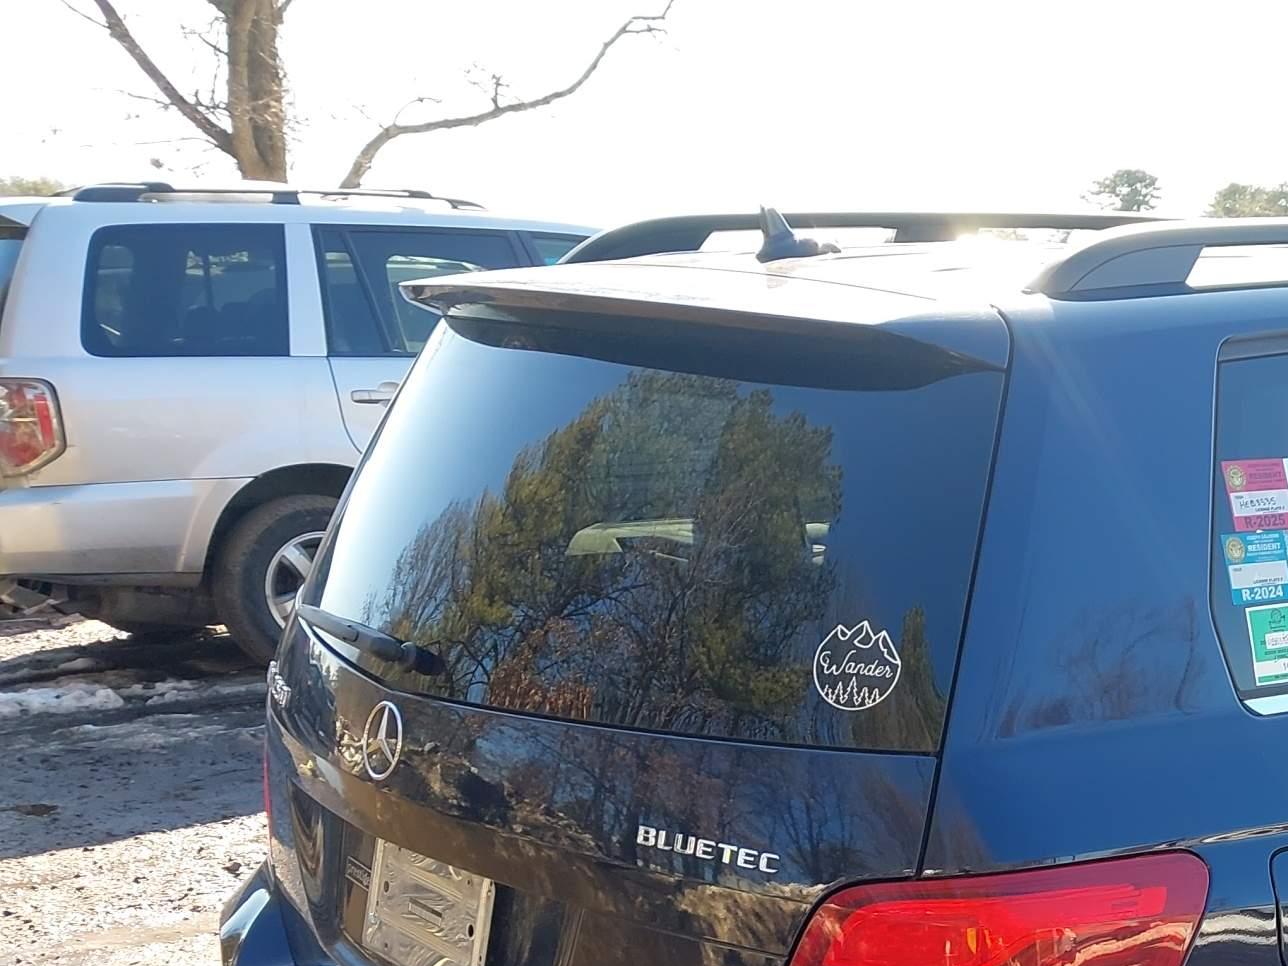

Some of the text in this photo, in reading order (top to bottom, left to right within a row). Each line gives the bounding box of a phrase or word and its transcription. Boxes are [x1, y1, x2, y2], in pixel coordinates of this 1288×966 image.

[1244, 514, 1286, 529] R-2025
[1247, 542, 1281, 552] RESIDENT
[1241, 585, 1284, 601] R-2024
[819, 649, 894, 679] Wander
[636, 824, 781, 875] BLUETEC
